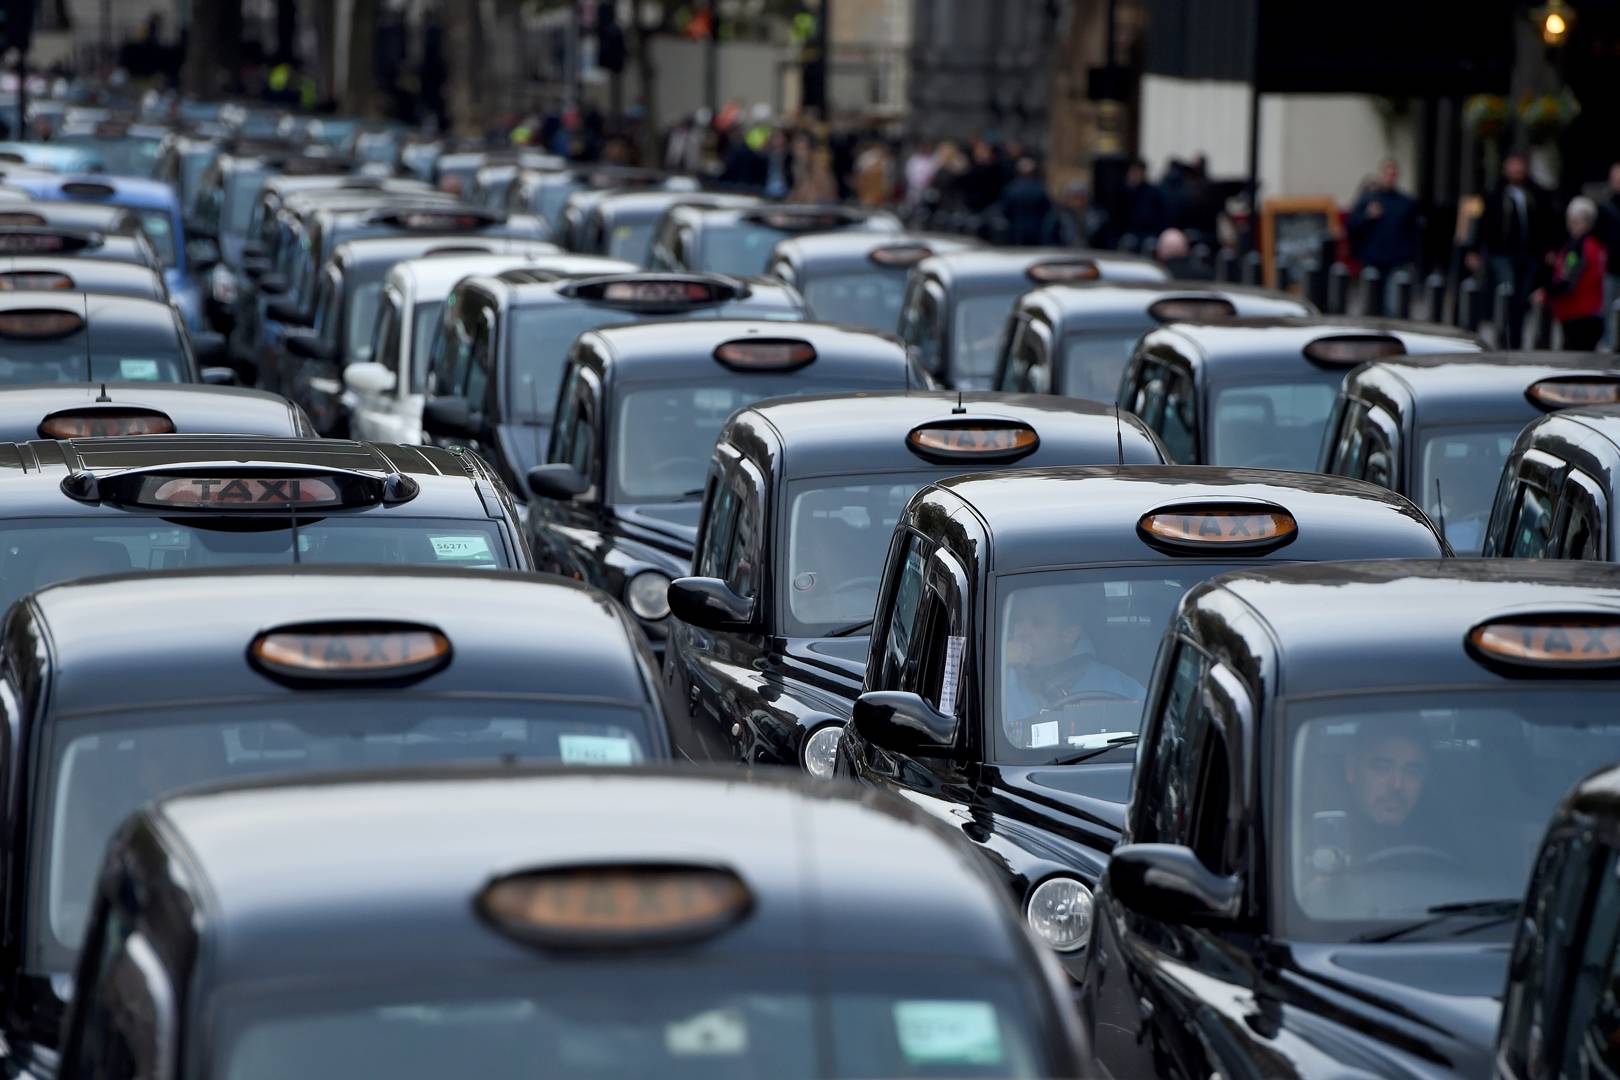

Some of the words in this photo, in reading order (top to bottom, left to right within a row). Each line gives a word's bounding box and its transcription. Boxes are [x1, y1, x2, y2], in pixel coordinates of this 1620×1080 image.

[938, 430, 1012, 448] TAXI
[192, 479, 299, 501] TAXI
[1175, 513, 1266, 537] TAXI
[297, 634, 411, 662] TAXI
[1518, 624, 1620, 653] TAX
